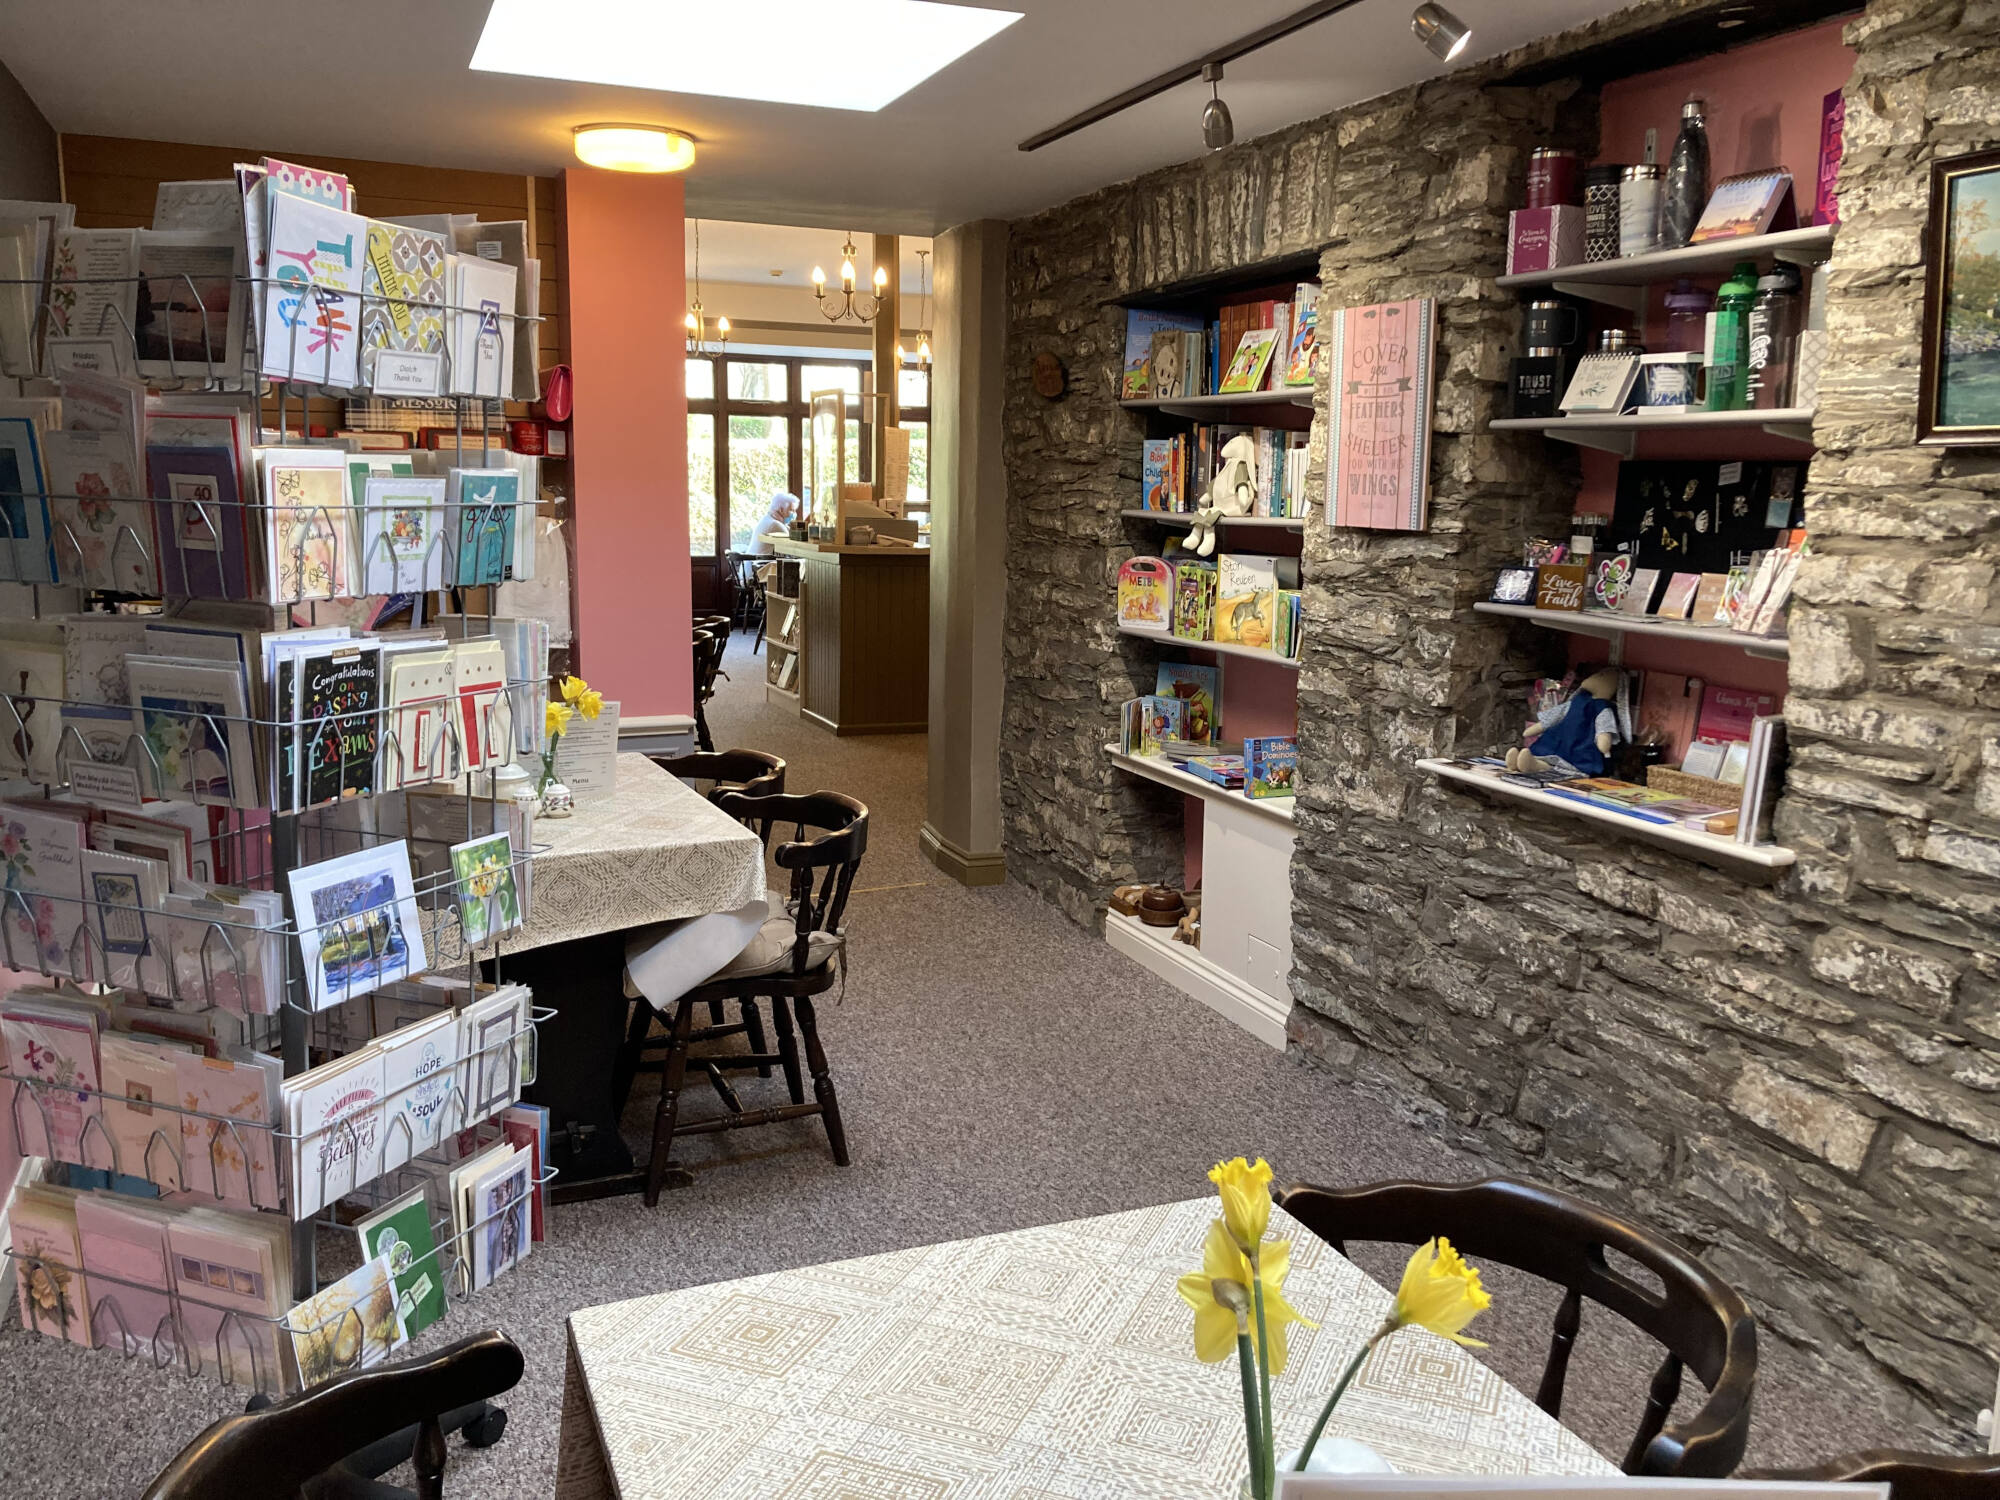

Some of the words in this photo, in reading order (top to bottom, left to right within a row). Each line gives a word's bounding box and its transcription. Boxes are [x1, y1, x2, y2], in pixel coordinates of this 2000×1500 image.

[376, 251, 399, 298] THANK
[1352, 343, 1409, 370] COVER
[1345, 432, 1408, 457] SHELTER
[1349, 474, 1398, 496] WINGS
[1542, 573, 1582, 591] Live
[1538, 585, 1584, 608] Faith
[312, 663, 375, 695] Congratulations
[338, 681, 355, 693] on
[415, 1056, 442, 1078] HOPE
[416, 1095, 443, 1117] SOUL
